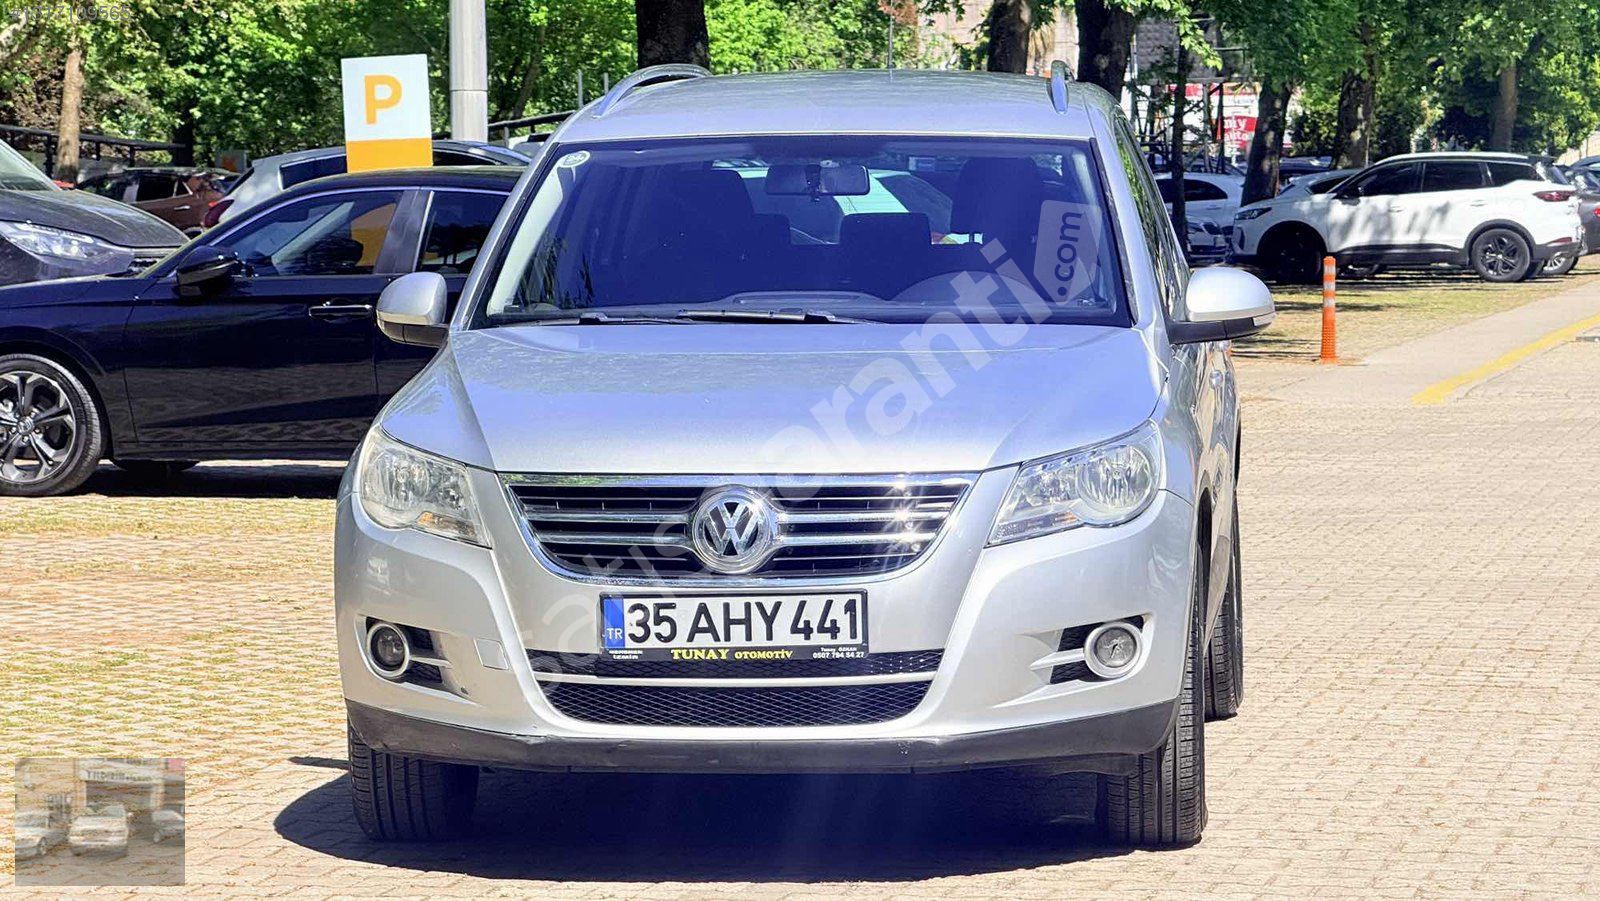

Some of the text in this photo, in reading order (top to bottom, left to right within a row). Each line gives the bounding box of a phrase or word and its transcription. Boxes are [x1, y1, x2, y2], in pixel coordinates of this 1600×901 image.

[364, 74, 403, 126] P
[606, 627, 624, 640] TR
[627, 599, 857, 643] 35 AHY 441
[671, 648, 730, 660] TUNAY
